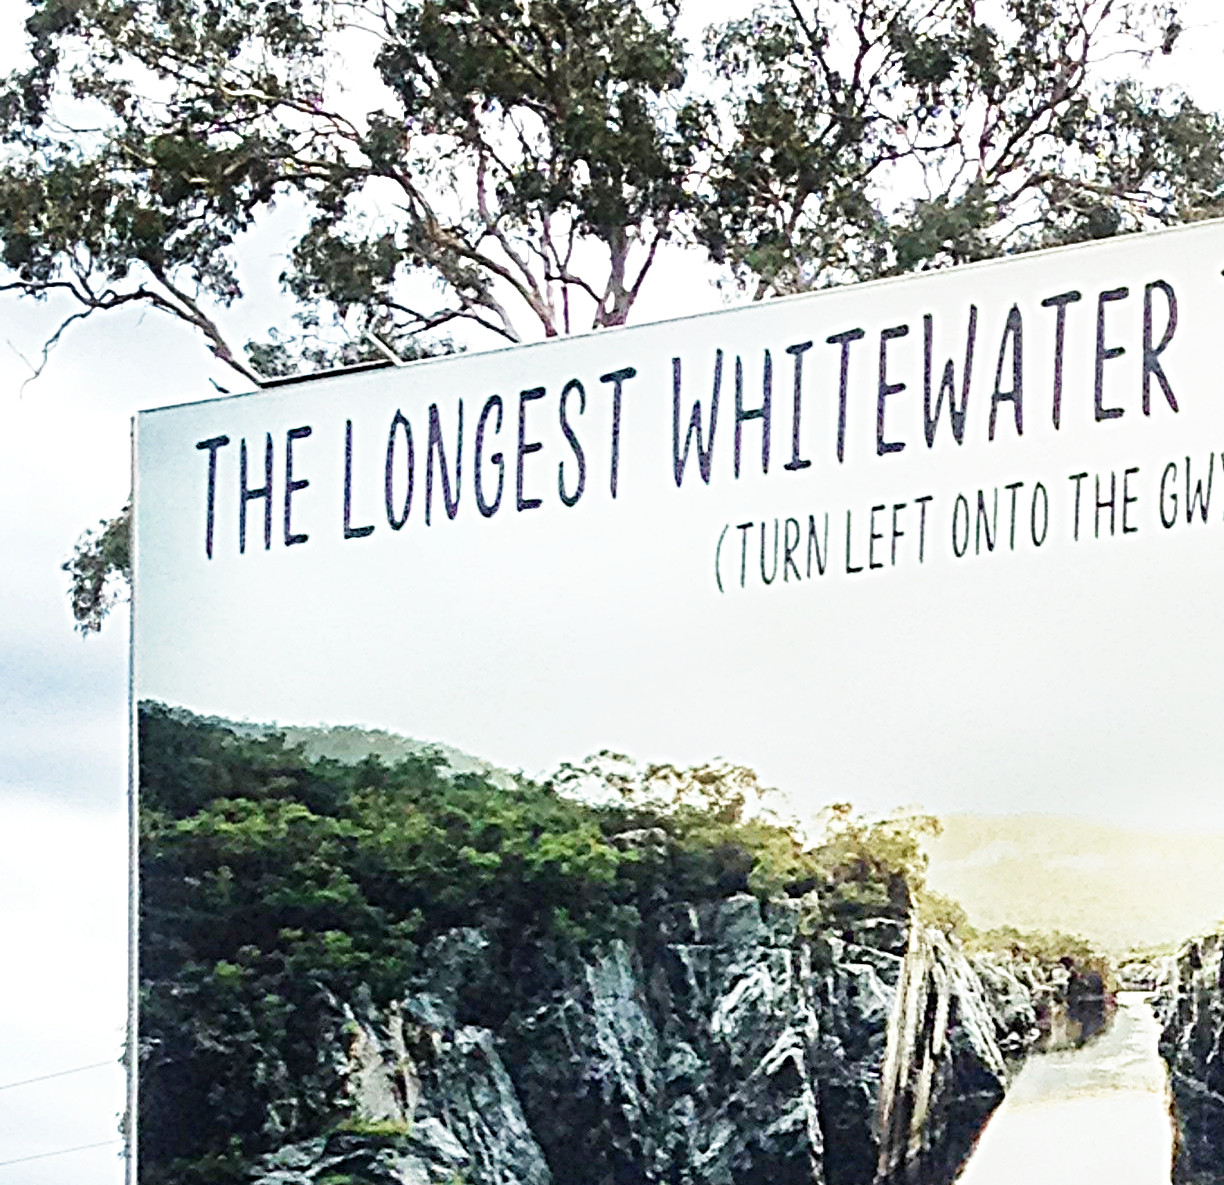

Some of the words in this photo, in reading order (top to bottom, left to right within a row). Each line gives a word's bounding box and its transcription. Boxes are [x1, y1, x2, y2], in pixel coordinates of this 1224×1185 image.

[197, 426, 311, 559] THE
[344, 367, 636, 540] LONGEST
[672, 279, 1179, 487] WHITEWATER
[715, 512, 829, 593] (TURN
[845, 496, 933, 573] LEFT
[952, 481, 1048, 559] ONTO
[1068, 466, 1141, 540] THE
